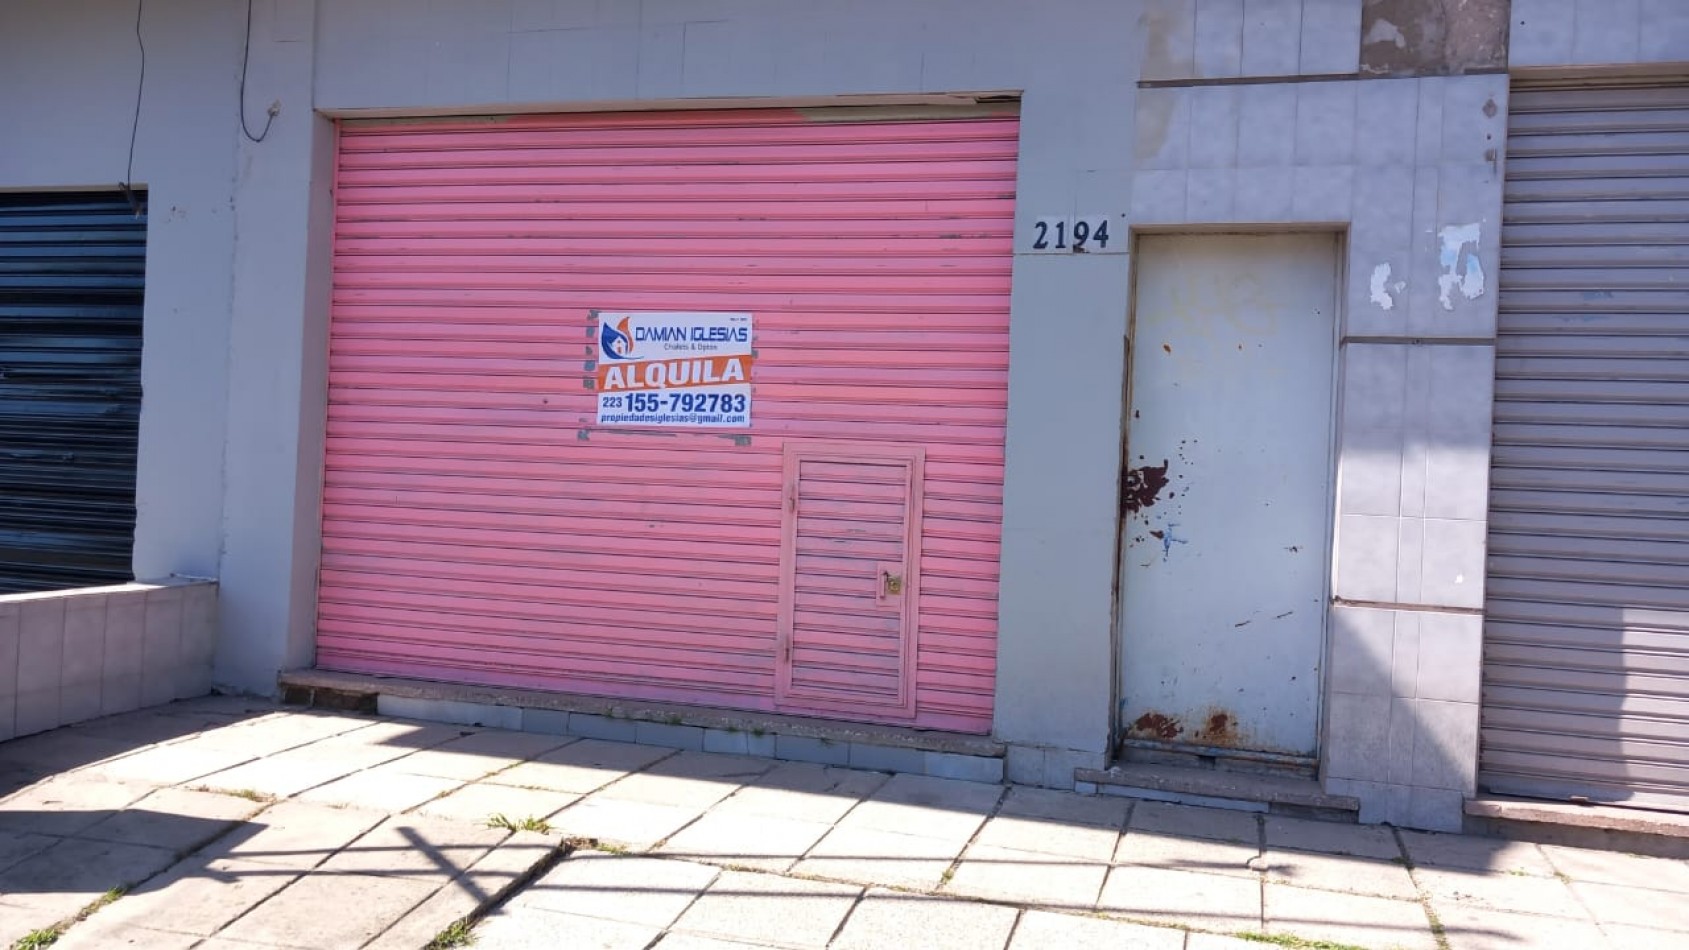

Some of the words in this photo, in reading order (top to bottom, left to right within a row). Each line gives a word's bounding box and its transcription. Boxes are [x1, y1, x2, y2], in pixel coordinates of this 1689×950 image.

[1032, 219, 1109, 249] 2194
[635, 327, 687, 342] DAMIAN
[690, 326, 748, 342] IGLESIAS
[603, 358, 744, 389] ALQUILA
[602, 396, 622, 408] 223
[625, 393, 746, 413] 155-792783
[601, 413, 745, 424] propiedadesiglesias@gmail.com
